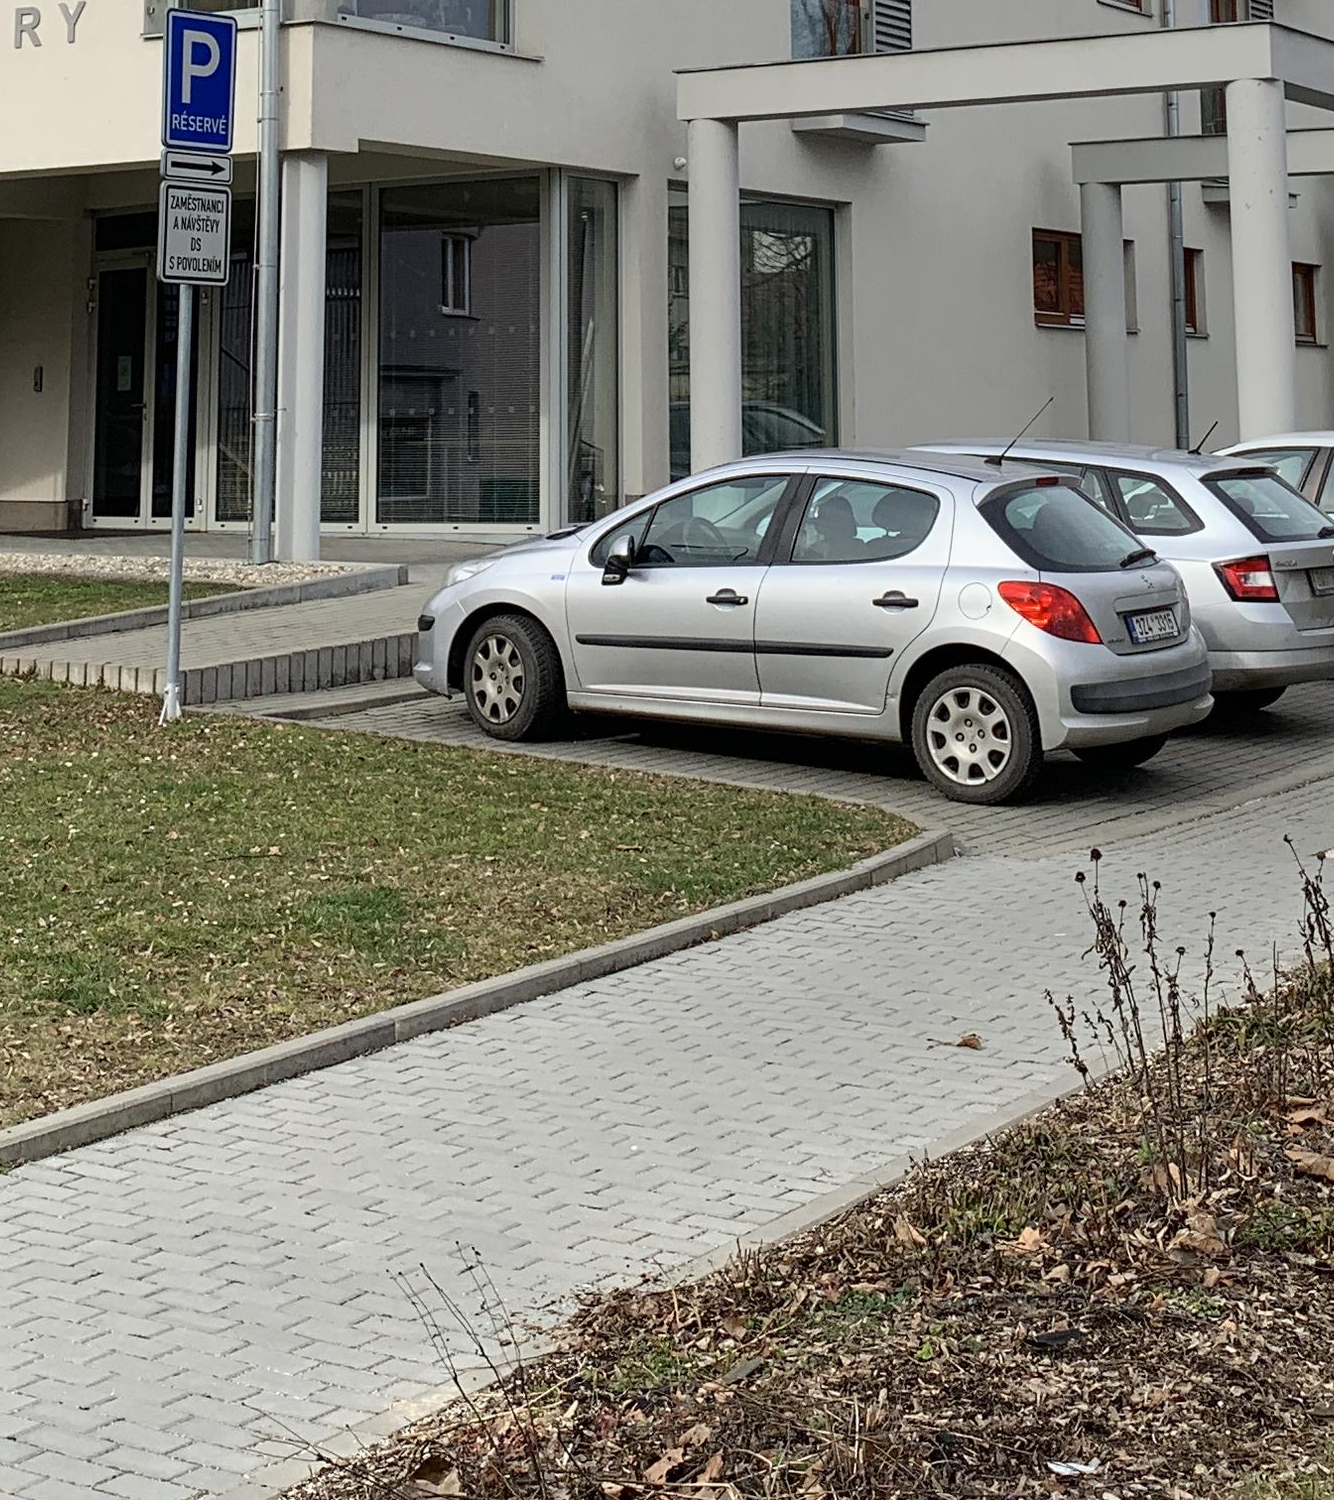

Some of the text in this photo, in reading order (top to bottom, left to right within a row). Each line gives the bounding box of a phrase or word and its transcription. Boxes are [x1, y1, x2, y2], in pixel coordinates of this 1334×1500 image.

[181, 29, 220, 104] P
[172, 111, 227, 135] RÉSERVÉ
[171, 193, 224, 214] ZAMĚSTNANCI
[173, 213, 220, 233] A NÁVŠTĚVY
[190, 236, 202, 252] DS
[169, 255, 222, 273] S POVOLENÍM
